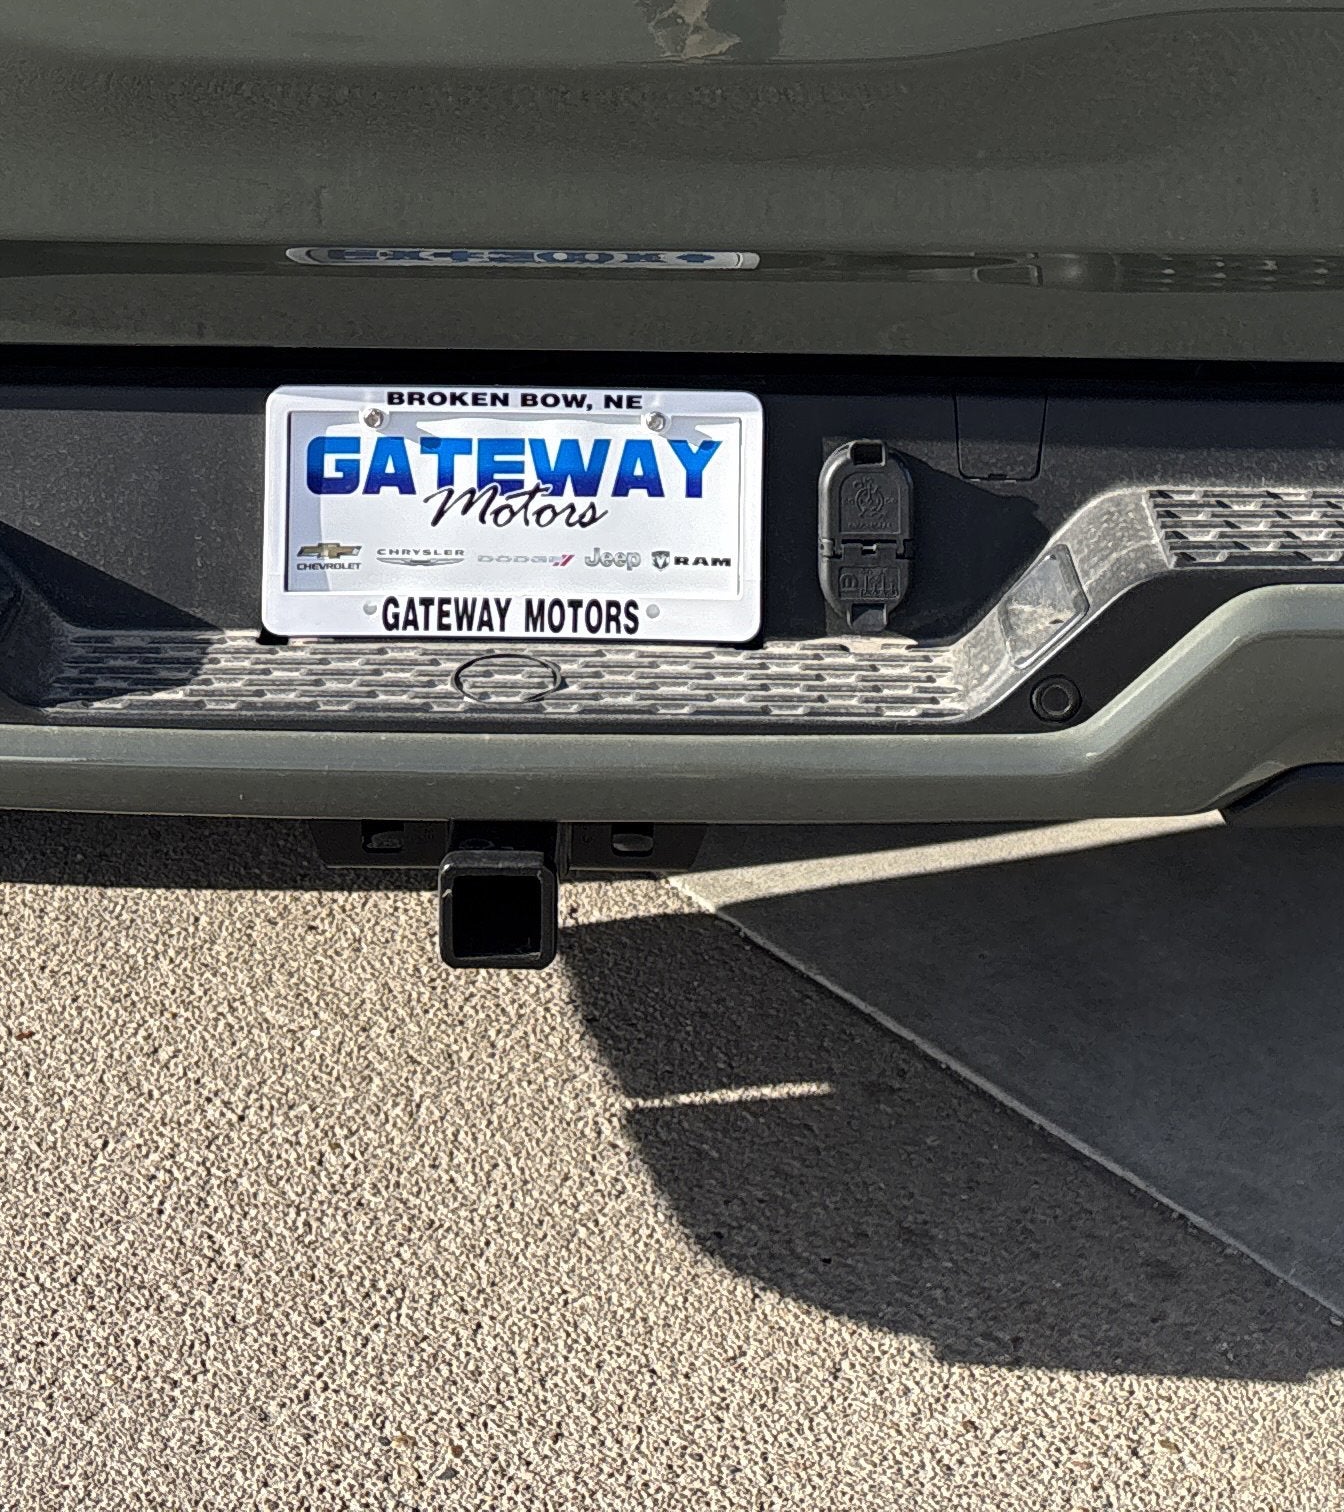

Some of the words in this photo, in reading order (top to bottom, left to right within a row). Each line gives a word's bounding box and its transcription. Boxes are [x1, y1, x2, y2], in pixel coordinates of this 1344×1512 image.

[386, 391, 510, 408] BROKEN
[520, 393, 594, 411] BOW,
[604, 394, 643, 409] NE
[306, 435, 722, 499] GATEWAY
[423, 481, 609, 528] Motors
[376, 548, 465, 556] CHRYSLER
[584, 547, 642, 571] Jeep
[674, 555, 732, 567] RAM
[296, 562, 362, 571] CHEVROLET
[381, 595, 512, 632] GATEWAY
[524, 597, 640, 635] MOTORS
